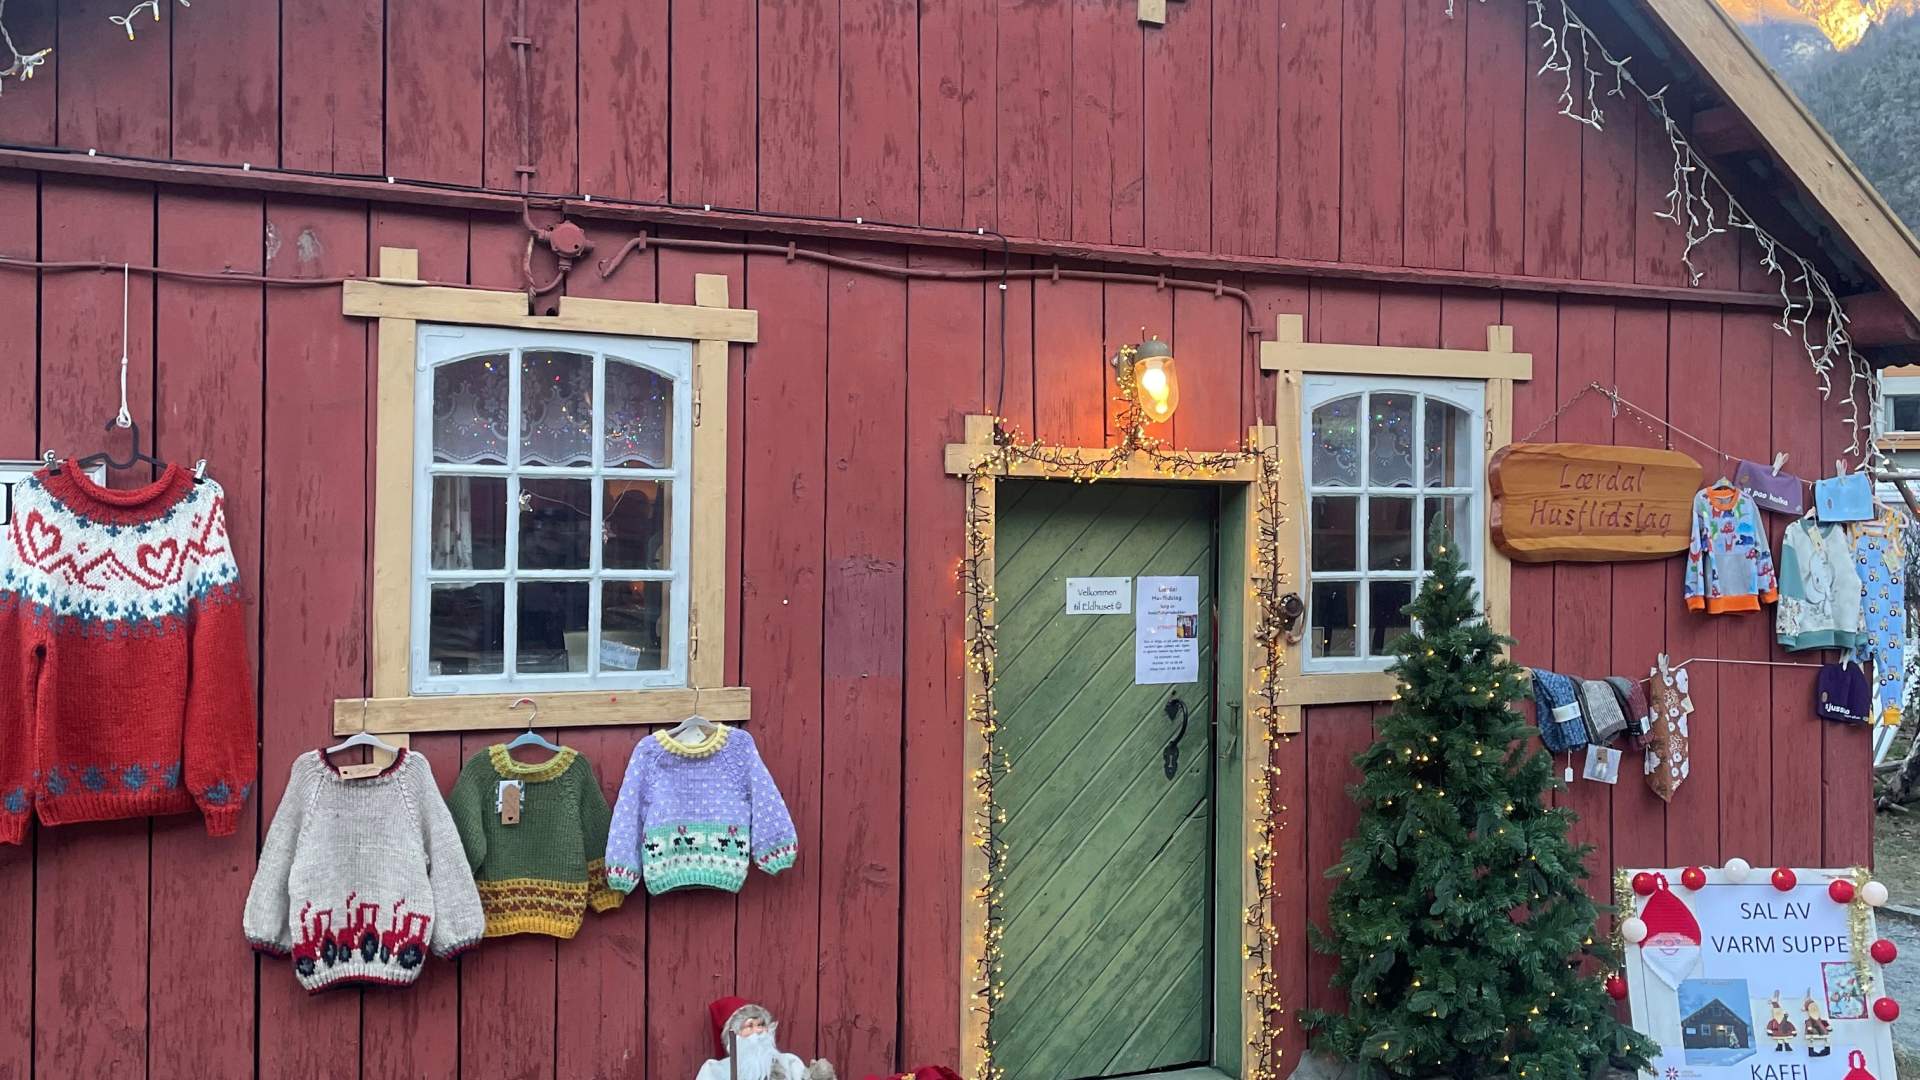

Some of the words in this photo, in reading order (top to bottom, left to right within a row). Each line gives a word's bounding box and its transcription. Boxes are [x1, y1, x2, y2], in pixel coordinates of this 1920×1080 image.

[1559, 463, 1645, 492] Lærdal
[1530, 499, 1673, 537] Husflidslag
[1078, 586, 1116, 596] Velkommen
[1740, 902, 1778, 920] SAL
[1783, 902, 1811, 920] AV
[1711, 936, 1775, 953] VARM
[1782, 935, 1849, 953] SUPPE
[1750, 1063, 1808, 1080] KAFFI
